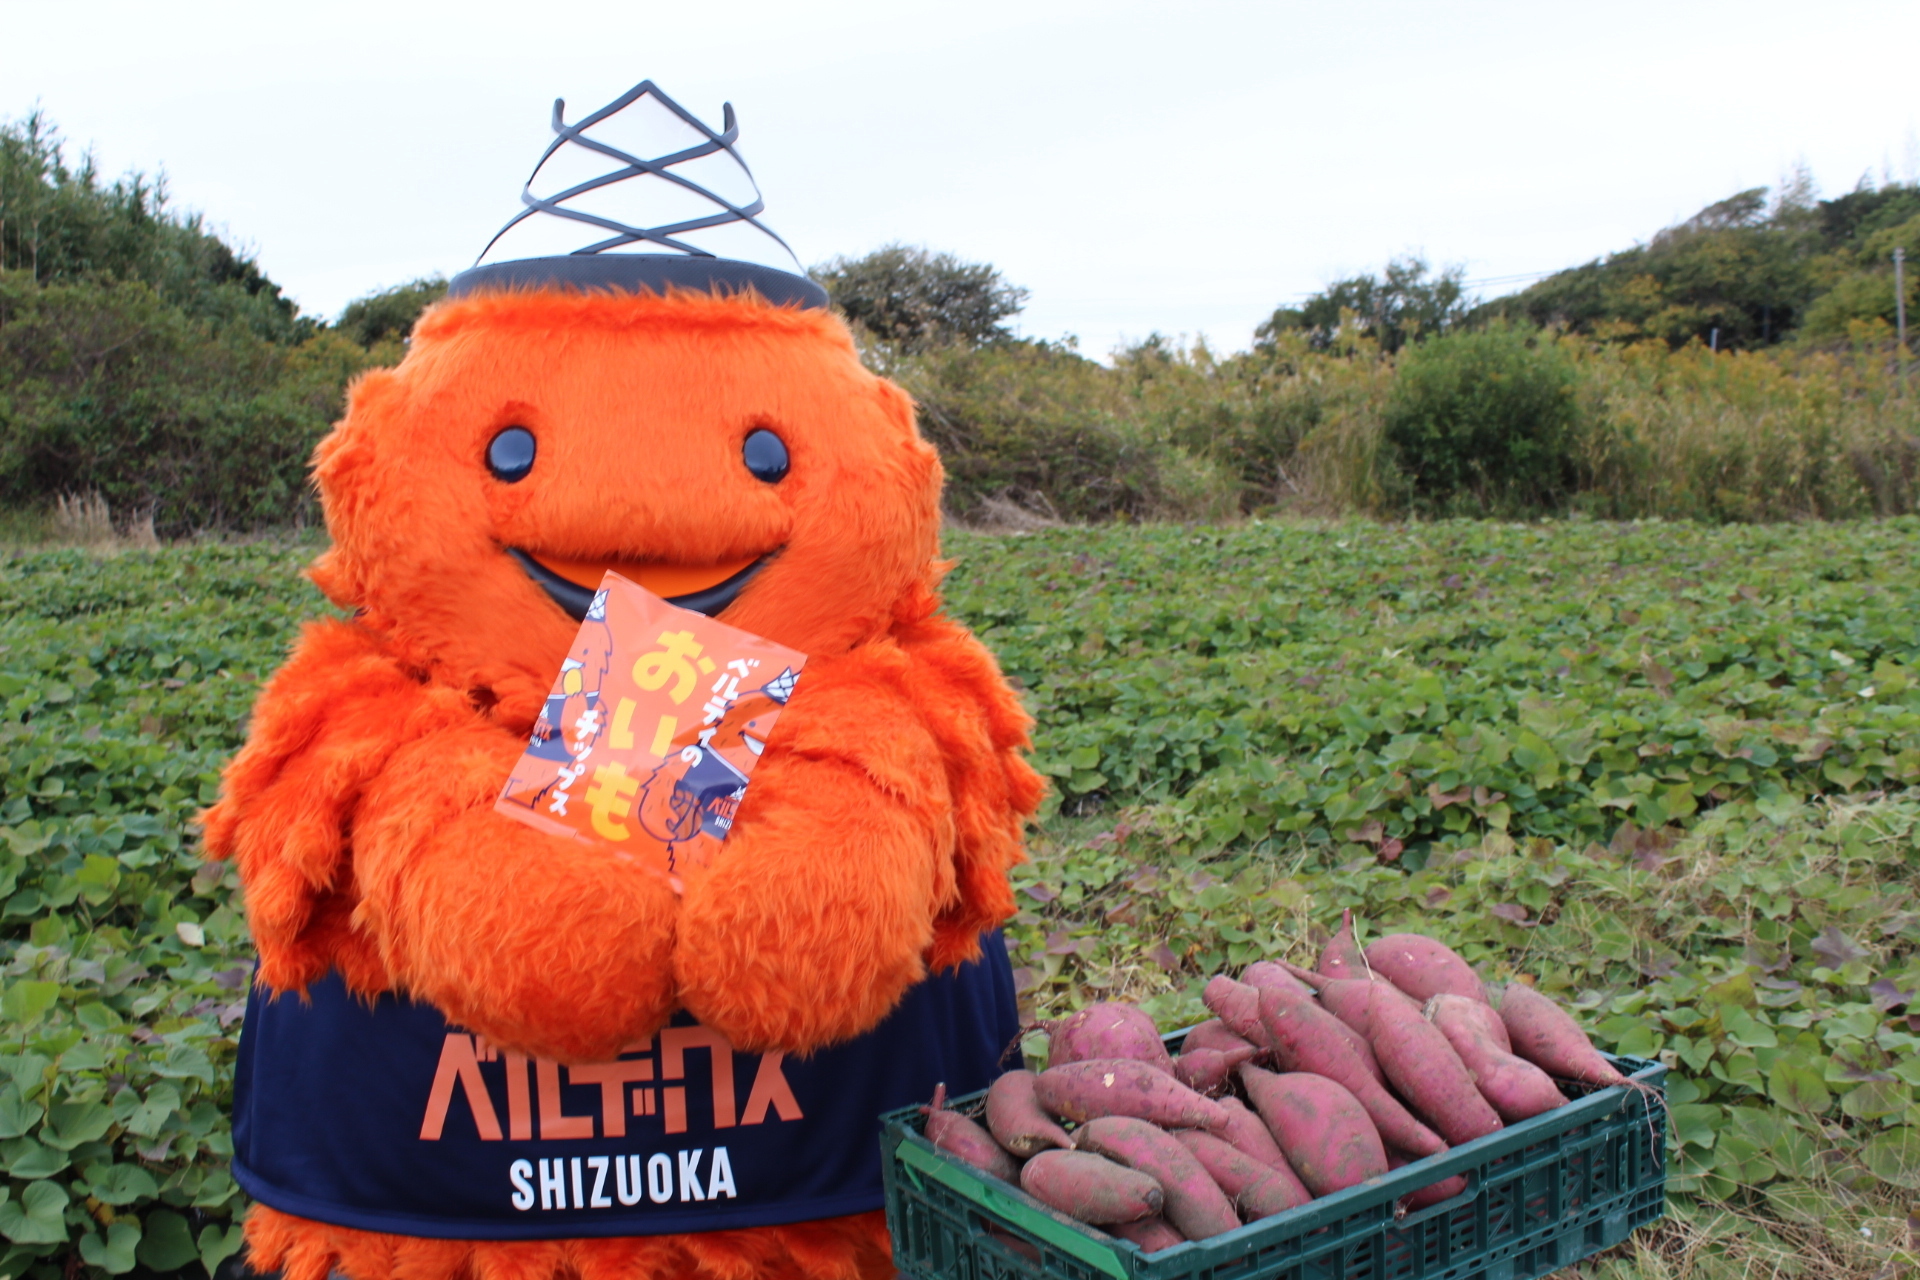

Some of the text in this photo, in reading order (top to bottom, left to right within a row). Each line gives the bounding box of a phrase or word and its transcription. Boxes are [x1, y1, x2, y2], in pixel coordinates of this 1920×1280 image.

[549, 709, 600, 817] チップス
[584, 629, 717, 842] おいも
[509, 1146, 737, 1211] SHIZUOKA
